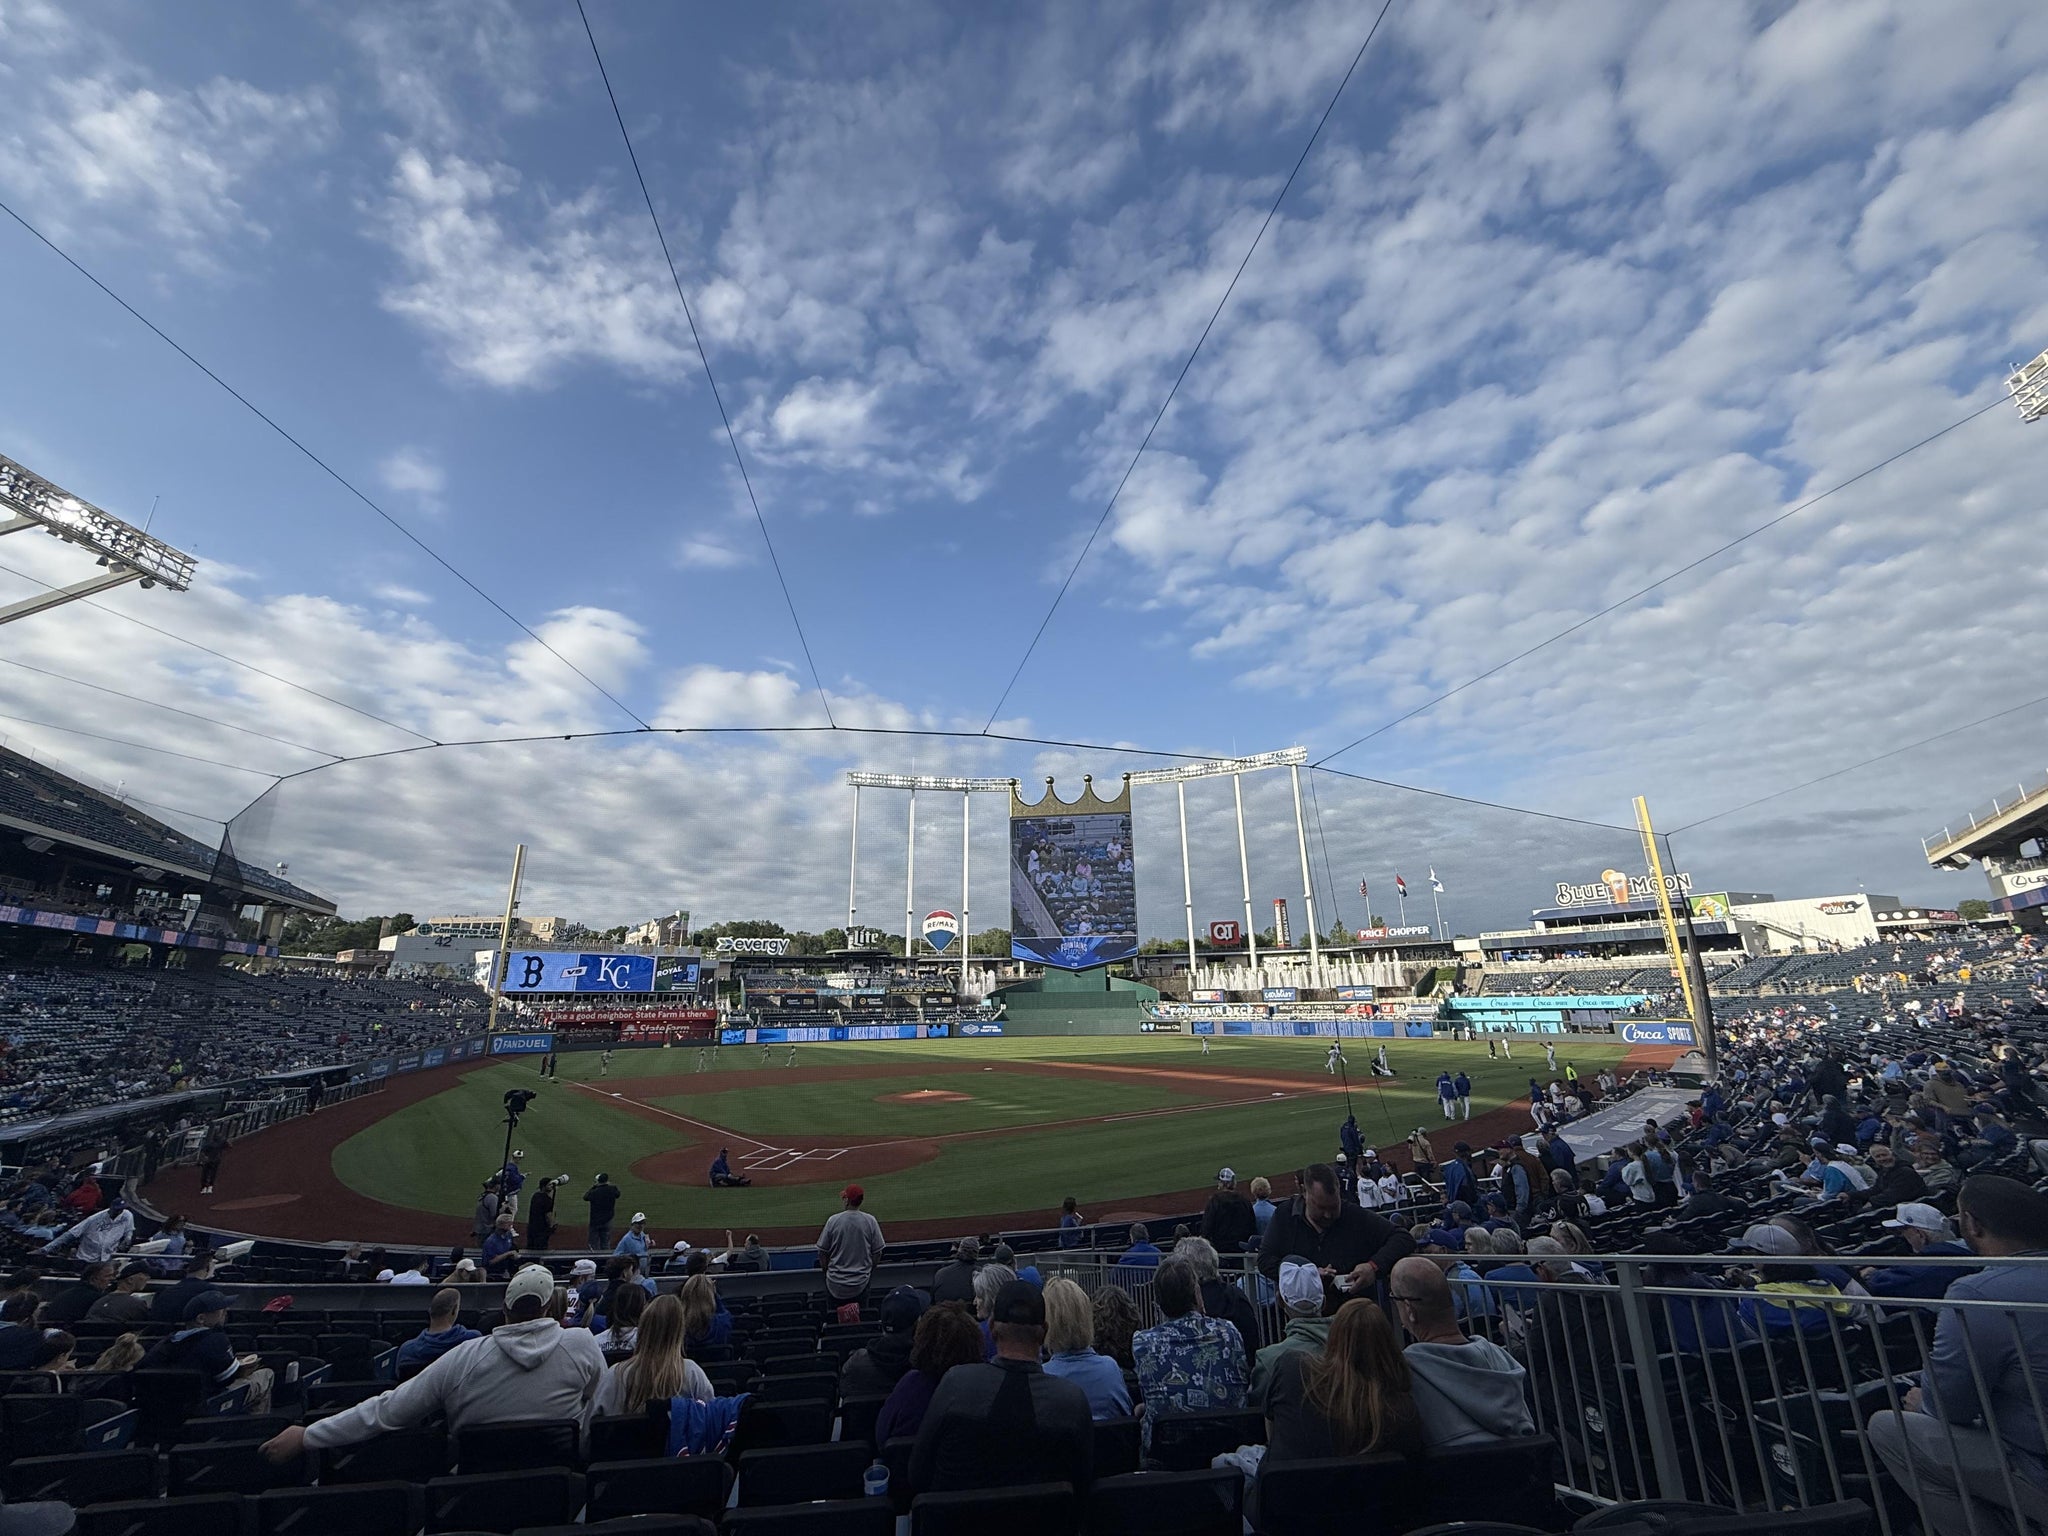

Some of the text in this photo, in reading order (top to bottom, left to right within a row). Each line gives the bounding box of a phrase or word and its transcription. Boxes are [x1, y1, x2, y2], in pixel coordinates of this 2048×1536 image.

[1556, 883, 1607, 906] BLUE
[1822, 905, 1855, 914] RIVALS
[433, 926, 478, 935] Commerce
[927, 921, 954, 929] RE/MAX
[1213, 923, 1234, 940] QT
[1361, 926, 1430, 938] PRICE CHOPPER
[434, 936, 452, 947] 42
[850, 928, 879, 947] Lite
[735, 938, 789, 955] evergy
[519, 956, 544, 988] B
[597, 957, 630, 989] KC
[656, 966, 683, 978] ROYAL
[1451, 998, 1468, 1008] Circa
[1490, 998, 1509, 1008] Circa
[1533, 998, 1552, 1007] Circa
[1577, 997, 1597, 1007] Circa
[576, 1012, 596, 1021] good
[597, 1012, 634, 1020] neighbor,
[1170, 1007, 1223, 1017] FOUNTAIN
[1225, 1006, 1254, 1016] DECK
[1622, 1023, 1691, 1042] Circa SPORTS
[502, 1039, 548, 1049] FANDUEL
